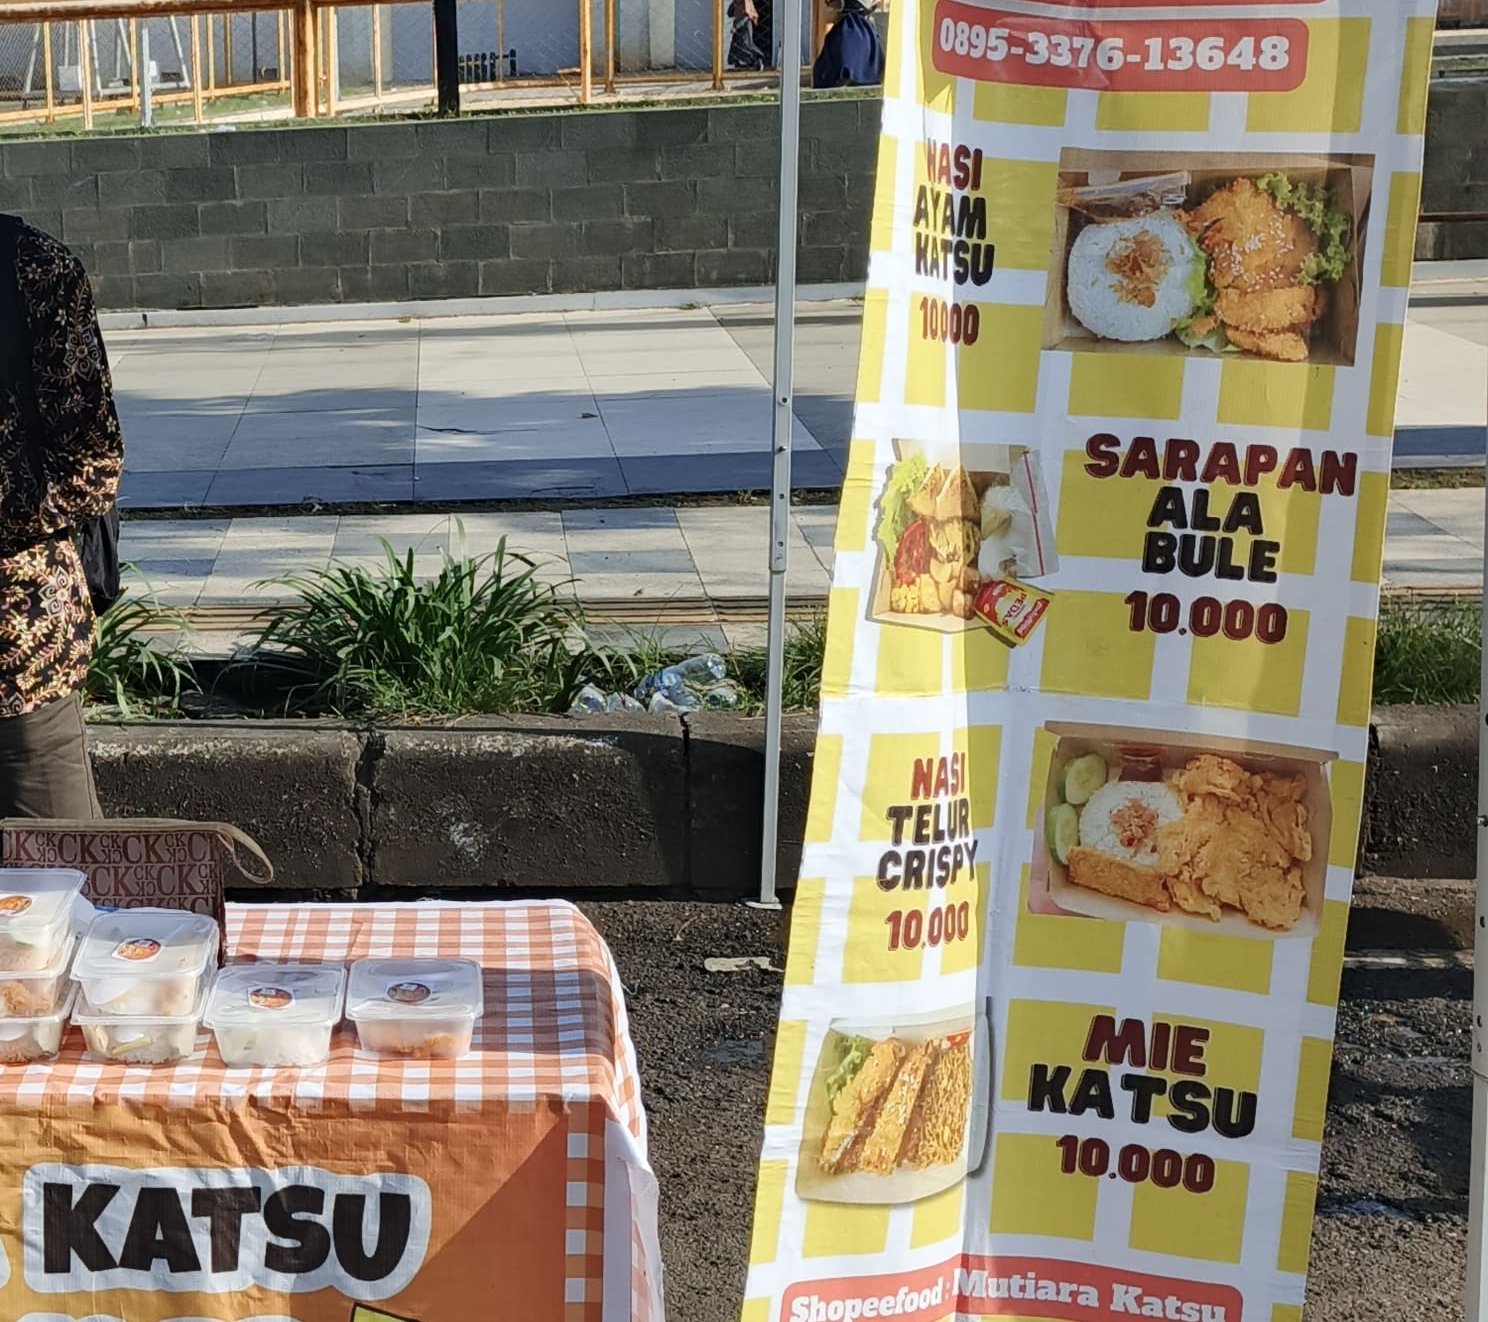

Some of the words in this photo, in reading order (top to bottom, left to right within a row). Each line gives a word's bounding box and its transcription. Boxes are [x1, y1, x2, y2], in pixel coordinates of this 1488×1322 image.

[939, 18, 1289, 71] 0895-3376-13648
[913, 185, 986, 240] AYAM
[915, 232, 995, 286] KATSU
[1084, 433, 1357, 496] SARAPAN
[1146, 486, 1264, 536] ALA
[1142, 531, 1280, 583] BULE
[1124, 590, 1288, 644] 10.000
[911, 752, 965, 800] NASI
[886, 798, 970, 846] TELUR
[876, 839, 978, 892] CRISPY
[885, 901, 969, 951] 10.000
[1082, 1015, 1210, 1076] MIE
[1027, 1063, 1256, 1138] KATSU
[1056, 1135, 1215, 1193] 10.000
[42, 1179, 410, 1281] KATSU
[952, 1268, 1099, 1308] Mutiara
